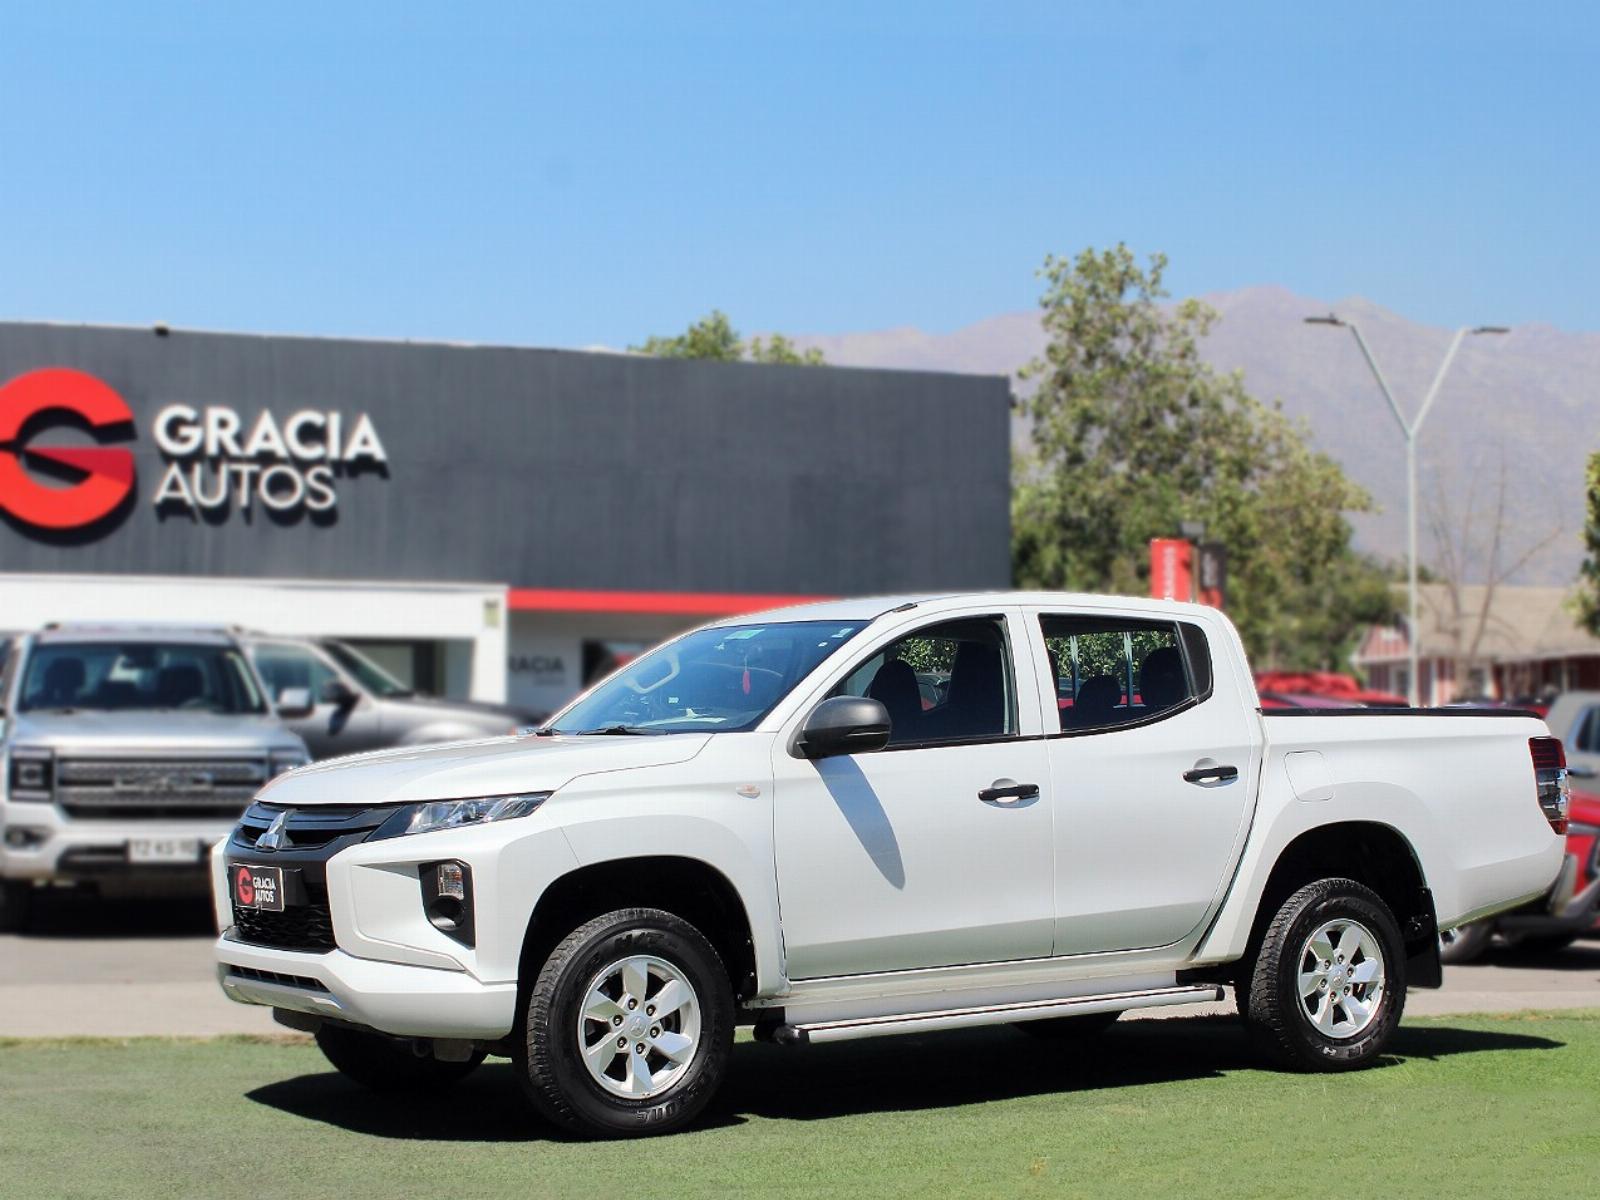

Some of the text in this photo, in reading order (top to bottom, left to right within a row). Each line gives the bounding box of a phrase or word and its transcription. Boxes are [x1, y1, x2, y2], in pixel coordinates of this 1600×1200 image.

[153, 404, 387, 460] GRACIA
[154, 463, 336, 510] AUTOS
[253, 876, 277, 891] GRACIA
[255, 889, 274, 903] AUTOS
